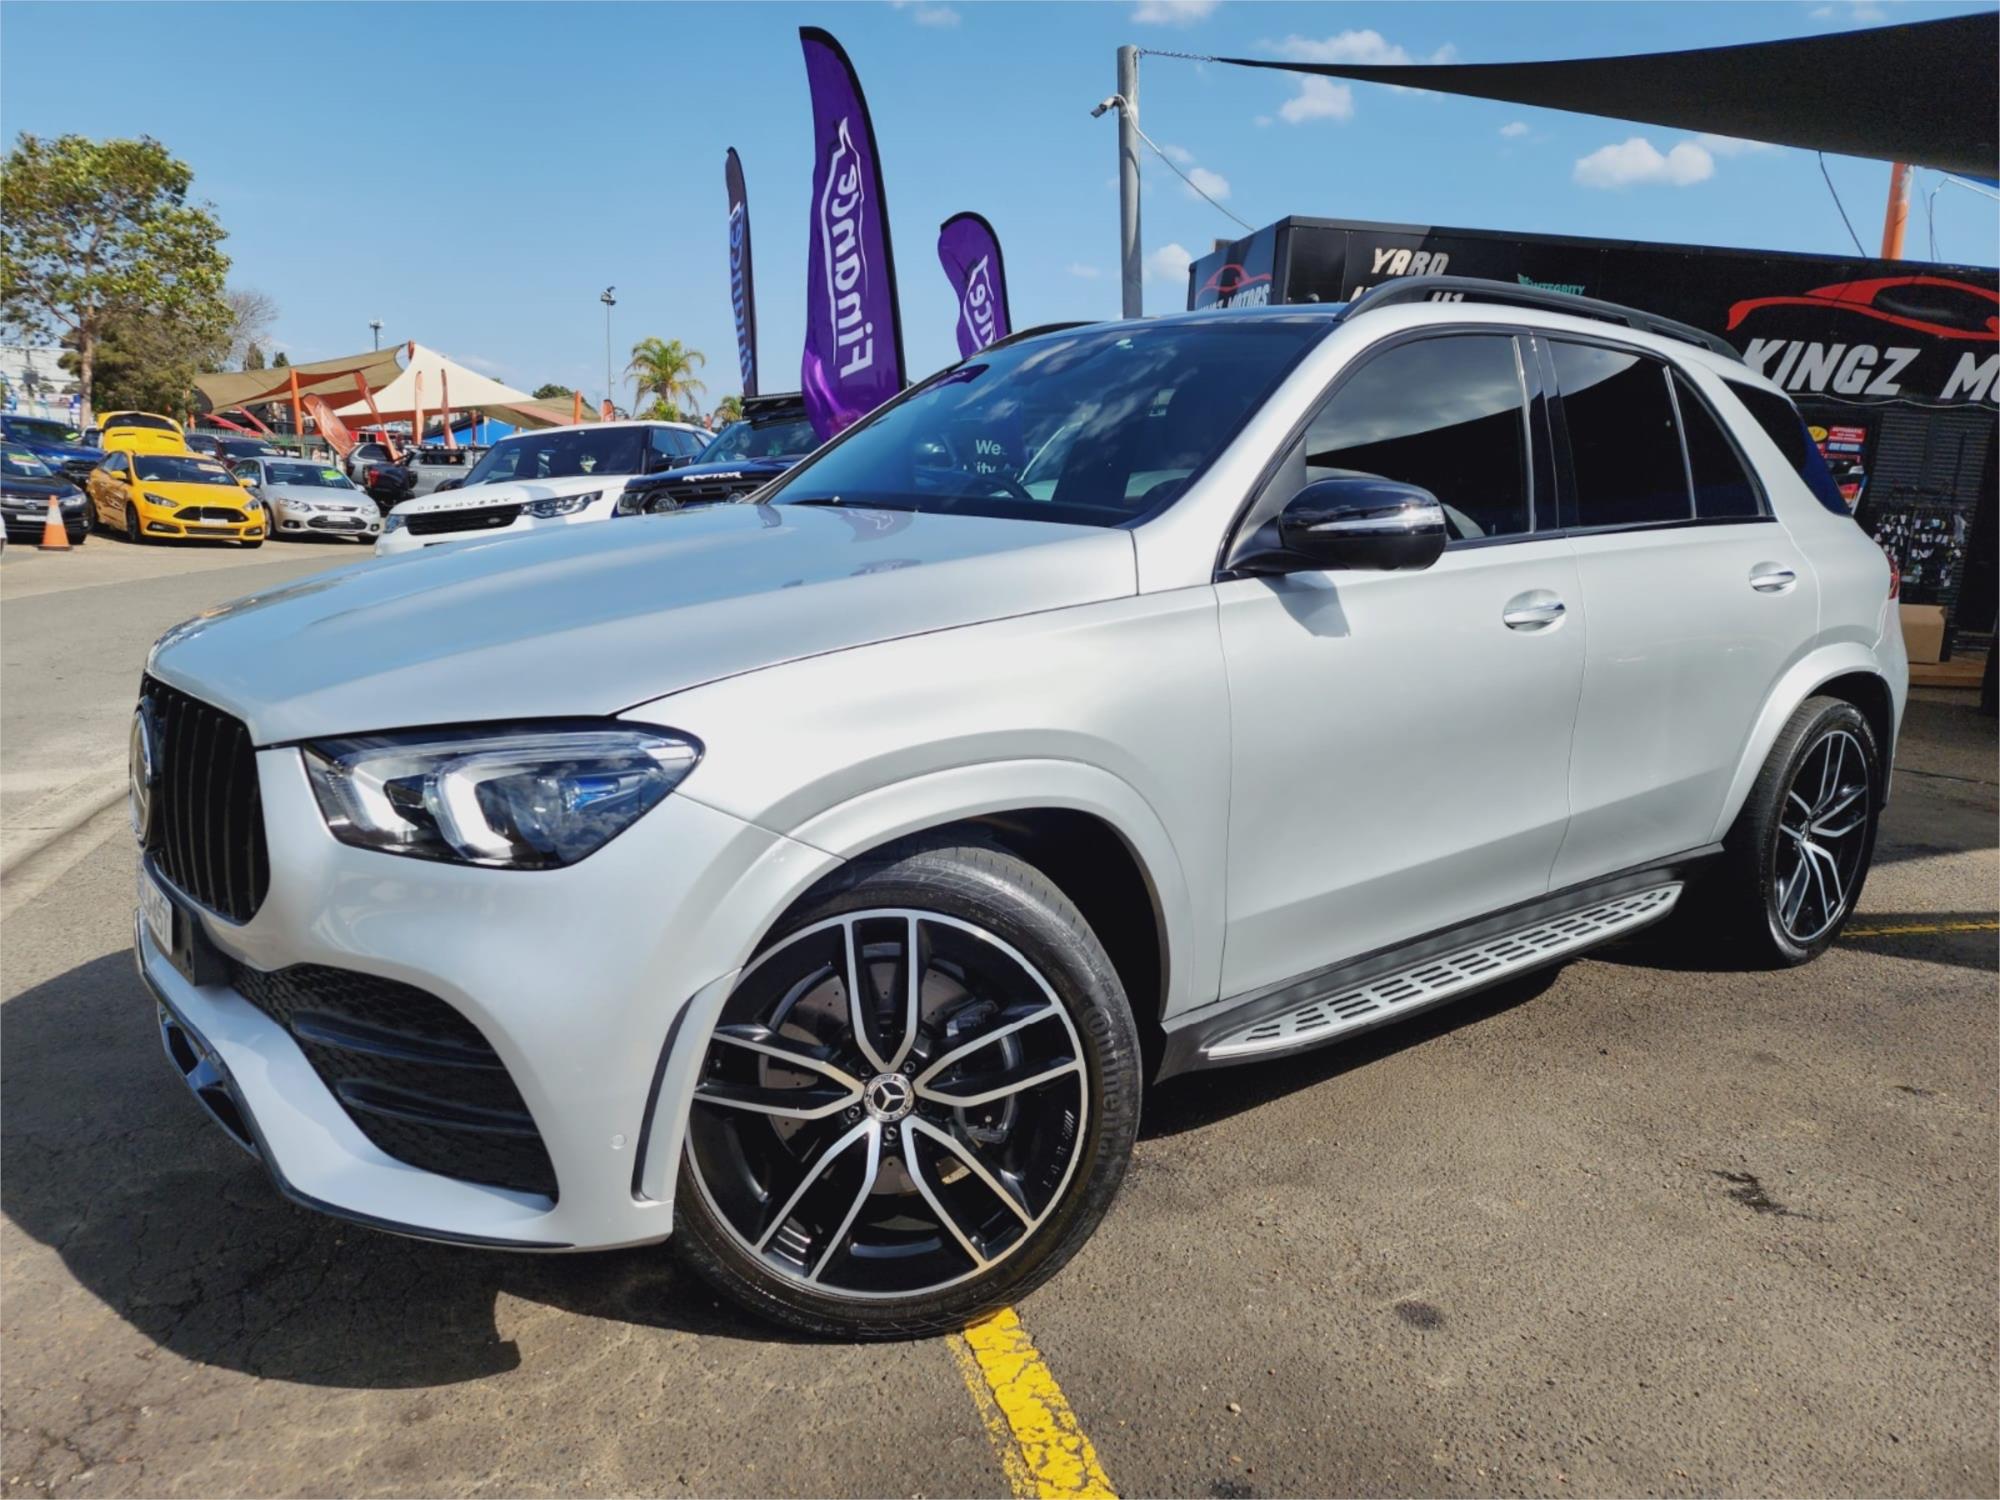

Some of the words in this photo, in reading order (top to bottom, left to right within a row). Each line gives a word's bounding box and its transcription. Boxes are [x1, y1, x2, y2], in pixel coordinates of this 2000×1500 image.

[1370, 248, 1450, 276] YARD
[1743, 338, 1921, 396] KINGZ
[1939, 352, 2000, 403] M
